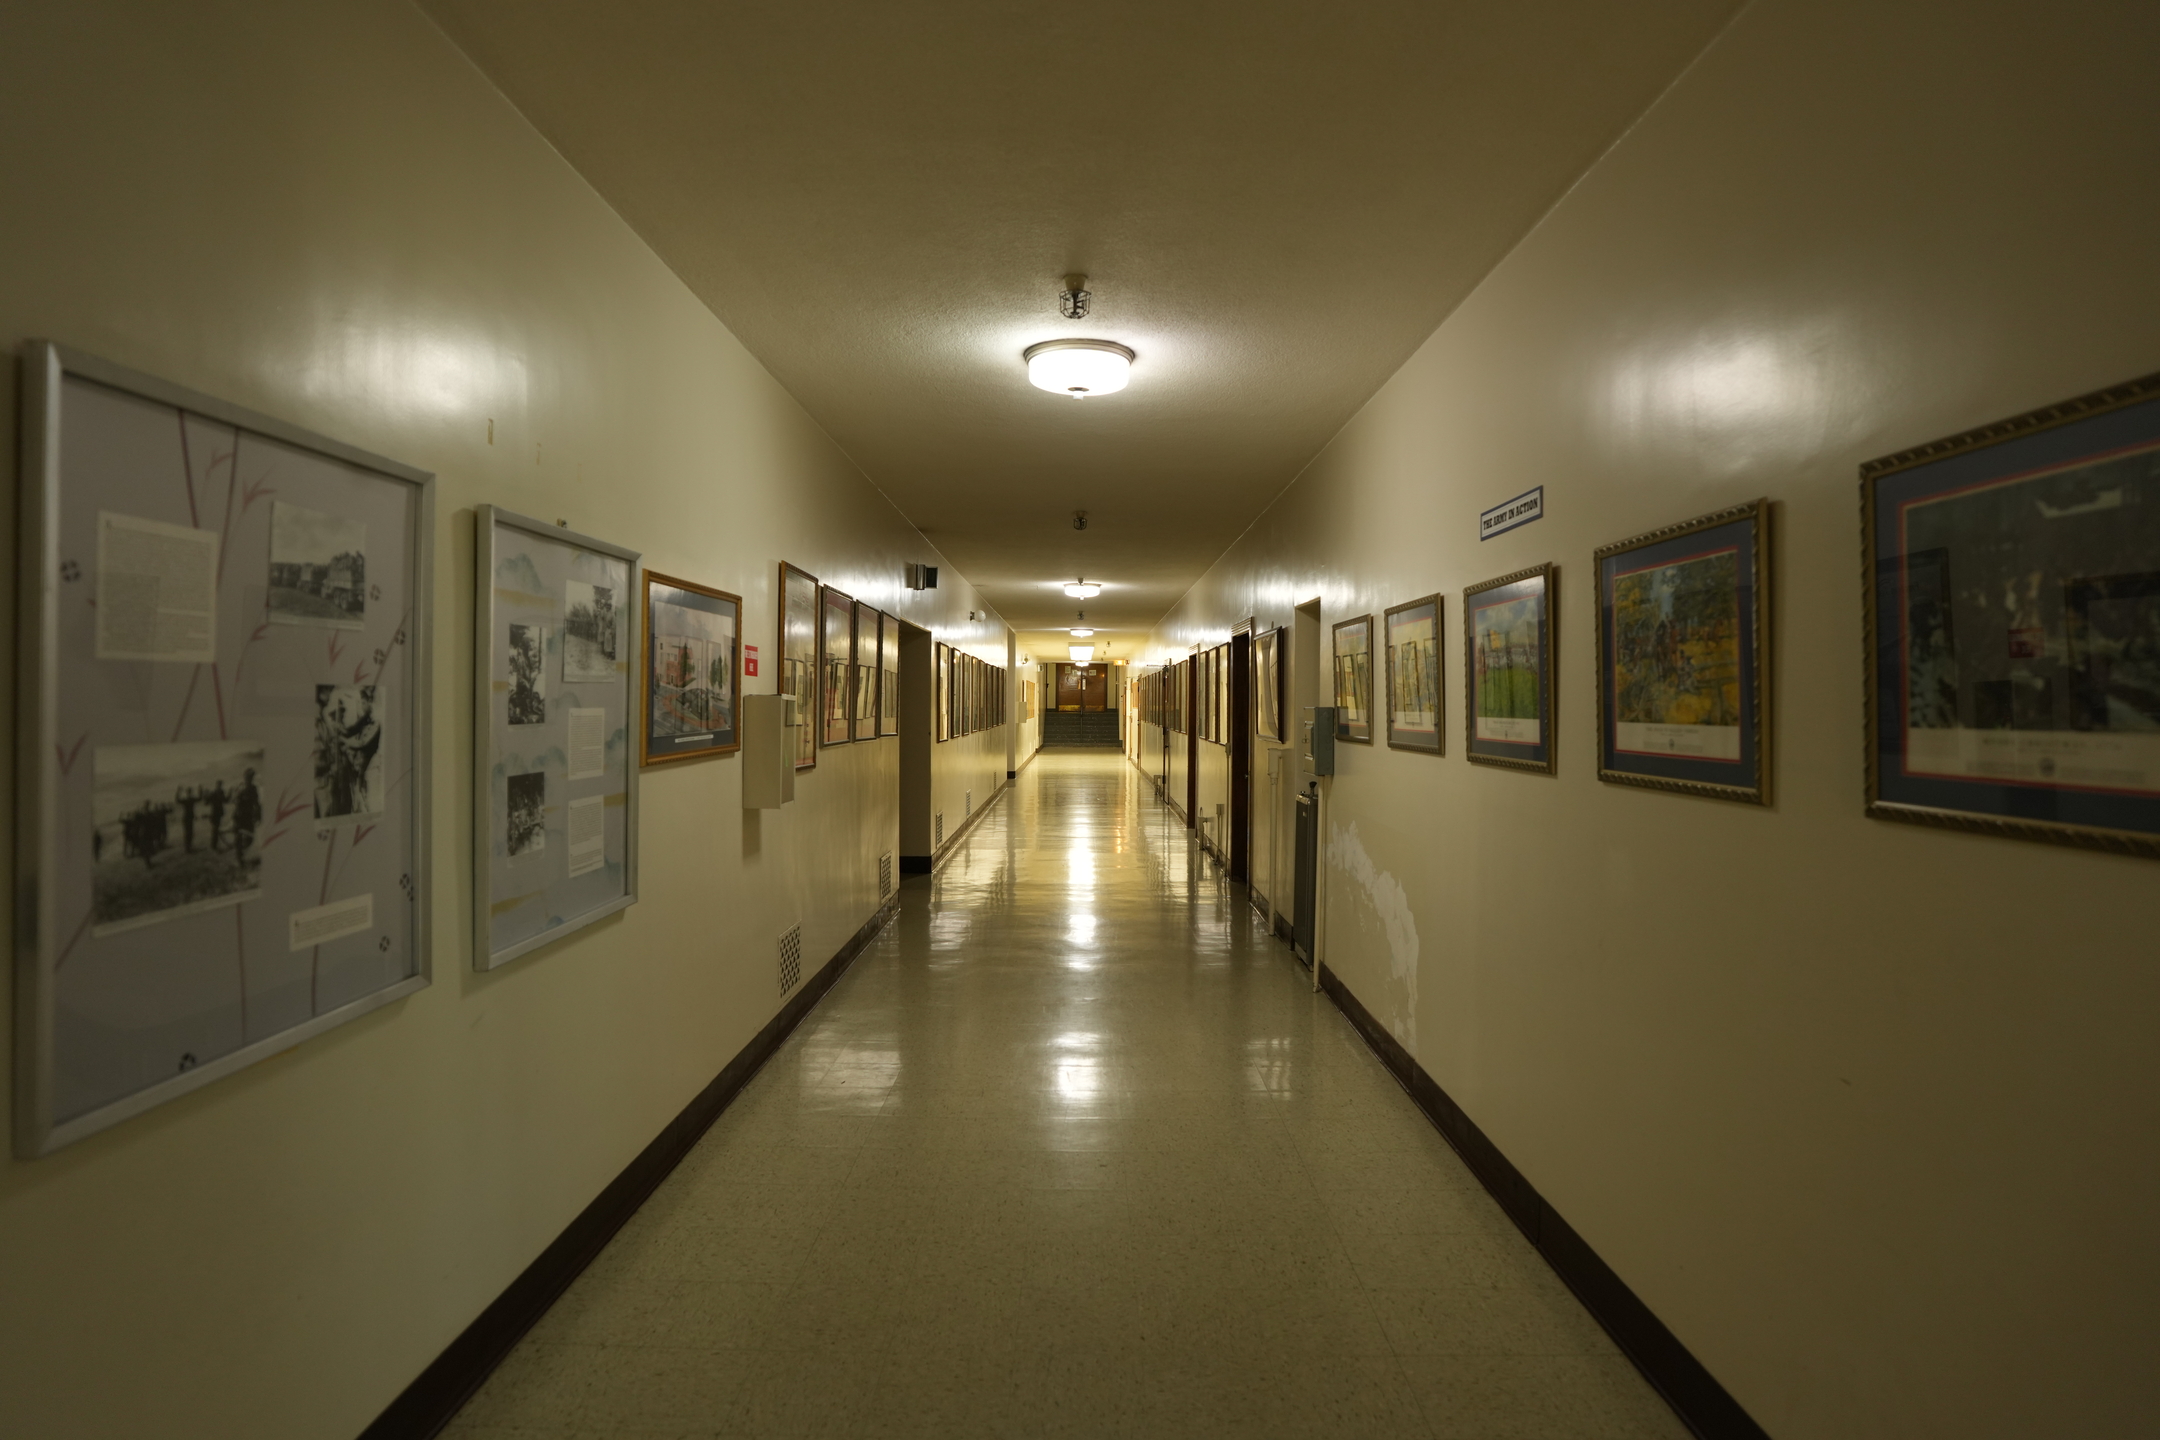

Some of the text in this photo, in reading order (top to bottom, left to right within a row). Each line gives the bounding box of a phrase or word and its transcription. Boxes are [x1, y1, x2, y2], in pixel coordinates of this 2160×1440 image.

[1483, 497, 1538, 530] THE ARMY IN ACTION
